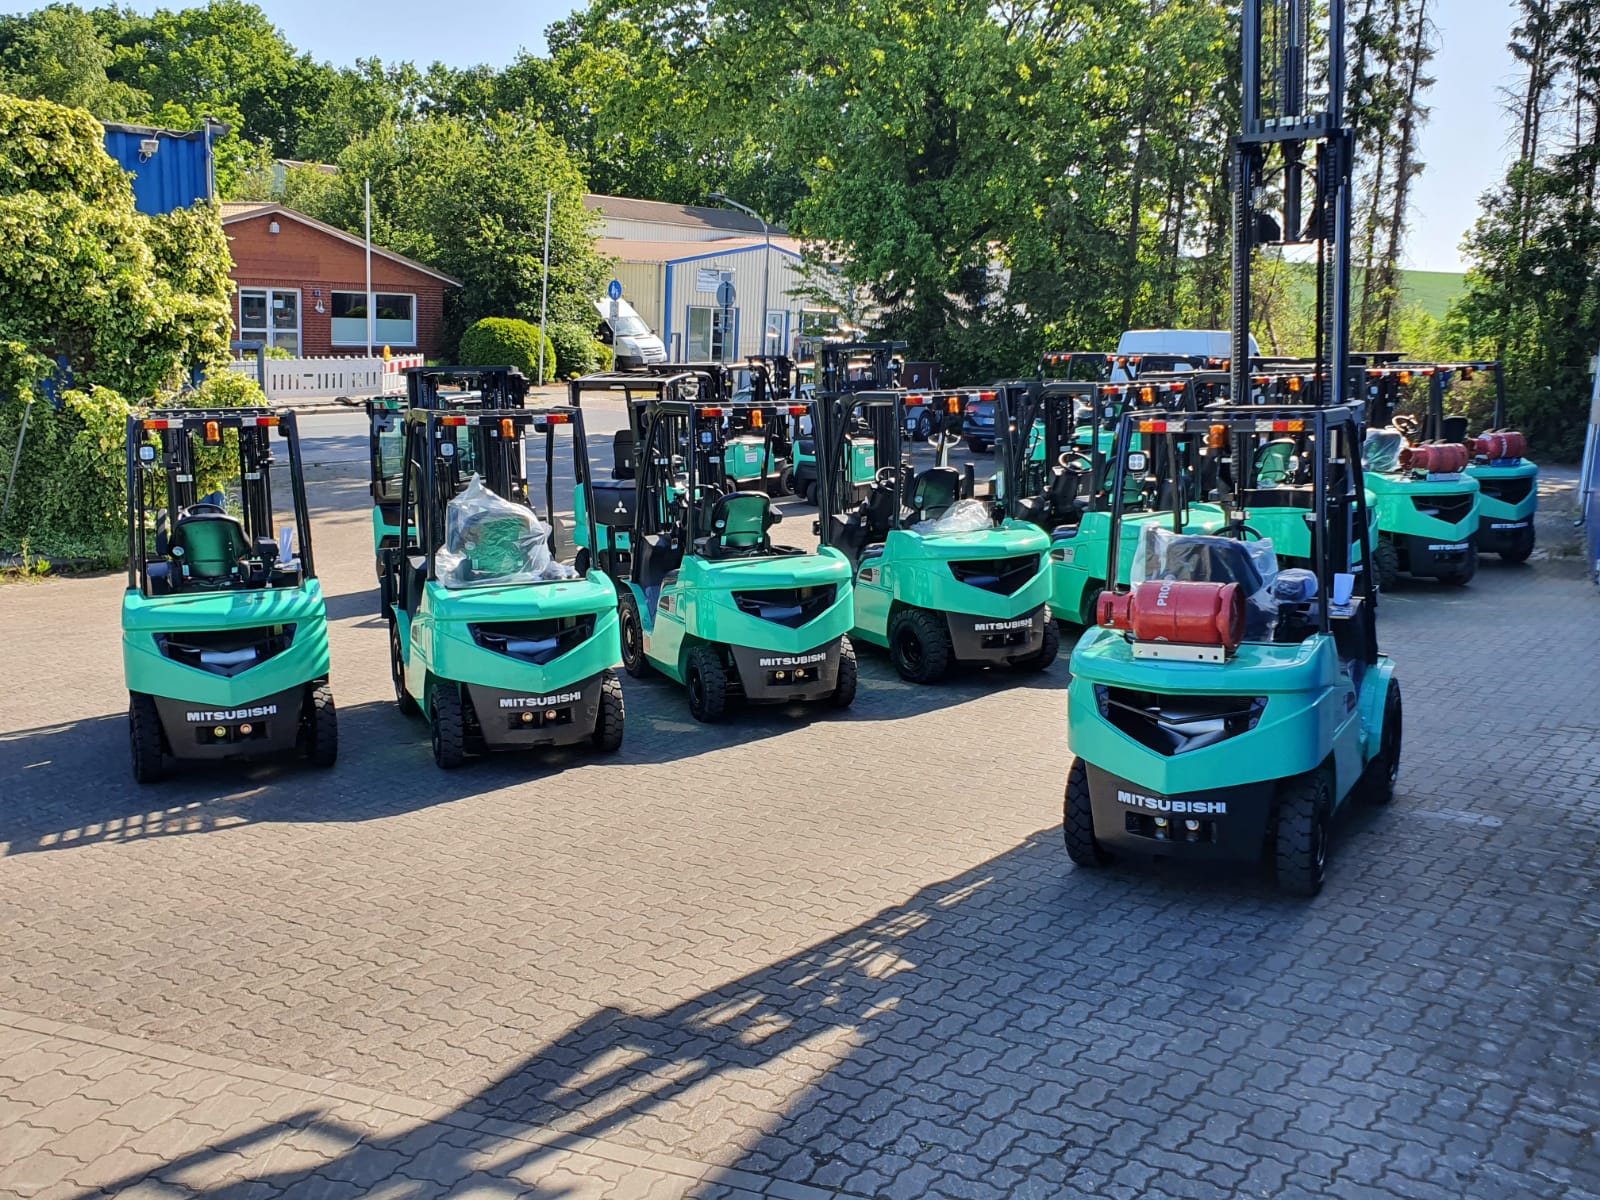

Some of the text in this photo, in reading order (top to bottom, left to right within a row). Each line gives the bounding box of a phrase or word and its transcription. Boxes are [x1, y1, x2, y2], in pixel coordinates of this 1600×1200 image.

[759, 652, 827, 666] MITSUBISHI
[499, 691, 581, 708] MITSUBISHI
[186, 705, 277, 721] MITSUBISHI
[1117, 789, 1227, 814] MITSUBISHI
